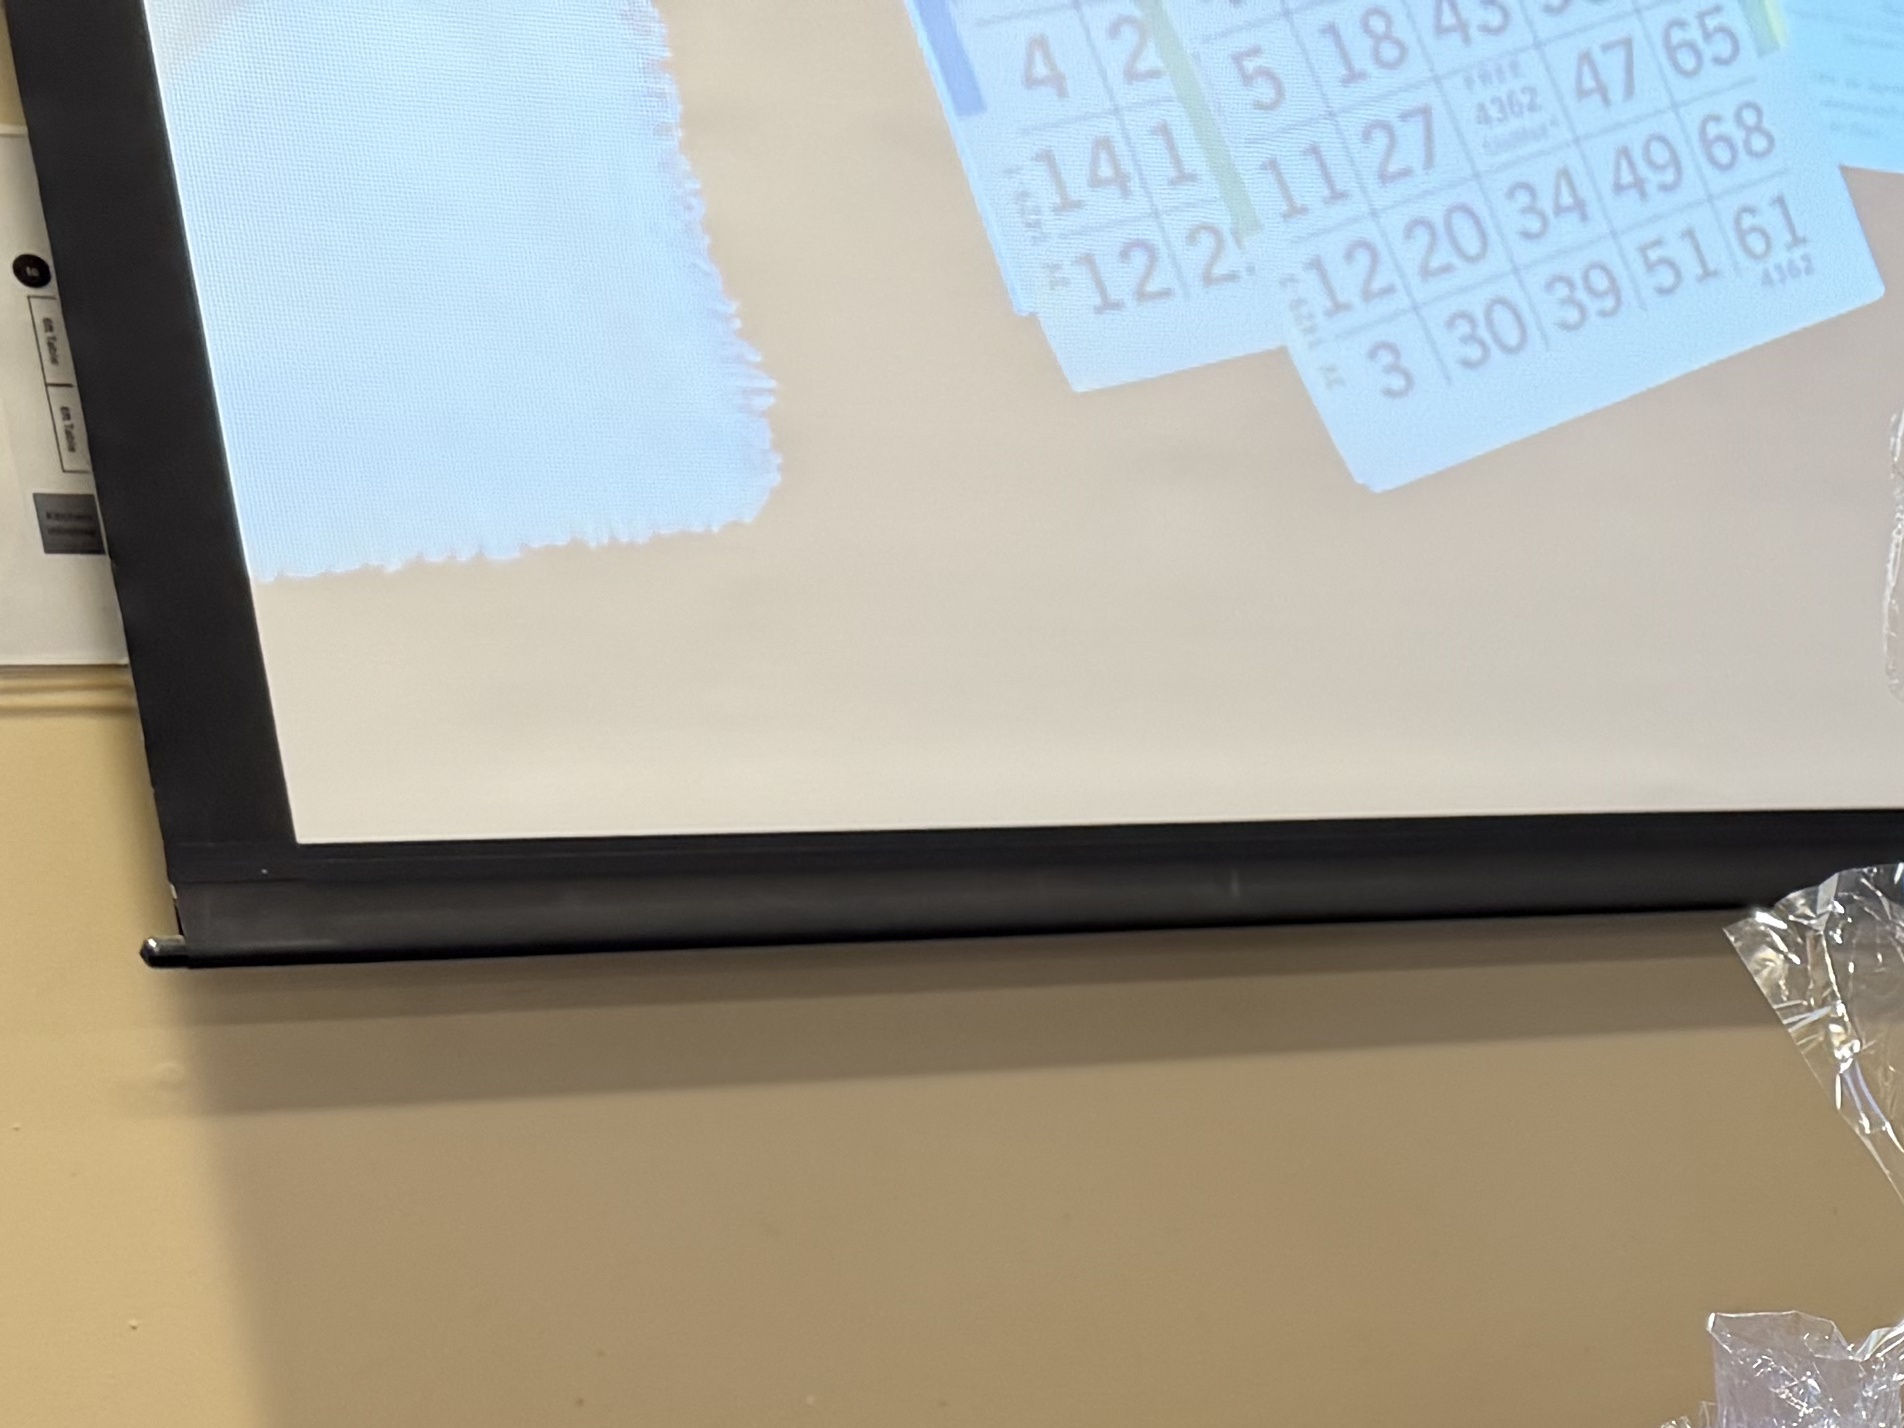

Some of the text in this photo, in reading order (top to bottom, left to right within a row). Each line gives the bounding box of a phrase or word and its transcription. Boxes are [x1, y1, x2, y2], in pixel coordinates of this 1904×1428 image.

[1023, 33, 1069, 98] 4
[1231, 46, 1284, 111] 5
[1321, 8, 1408, 85] 18
[1574, 35, 1637, 108] 47
[1663, 6, 1740, 79] 65
[1031, 135, 1130, 213] 14
[1362, 104, 1435, 188] 27
[1611, 132, 1683, 203] 49
[1698, 102, 1776, 173] 68
[1259, 142, 1349, 222] 11
[1505, 164, 1590, 240] 34
[1403, 202, 1489, 282] 20
[1637, 227, 1720, 295] 51
[1733, 195, 1808, 262] 61
[1074, 239, 1171, 314] 12
[1307, 239, 1396, 318] 12
[1544, 261, 1622, 333] 39
[1444, 296, 1528, 370] 30
[1367, 341, 1416, 399] 3
